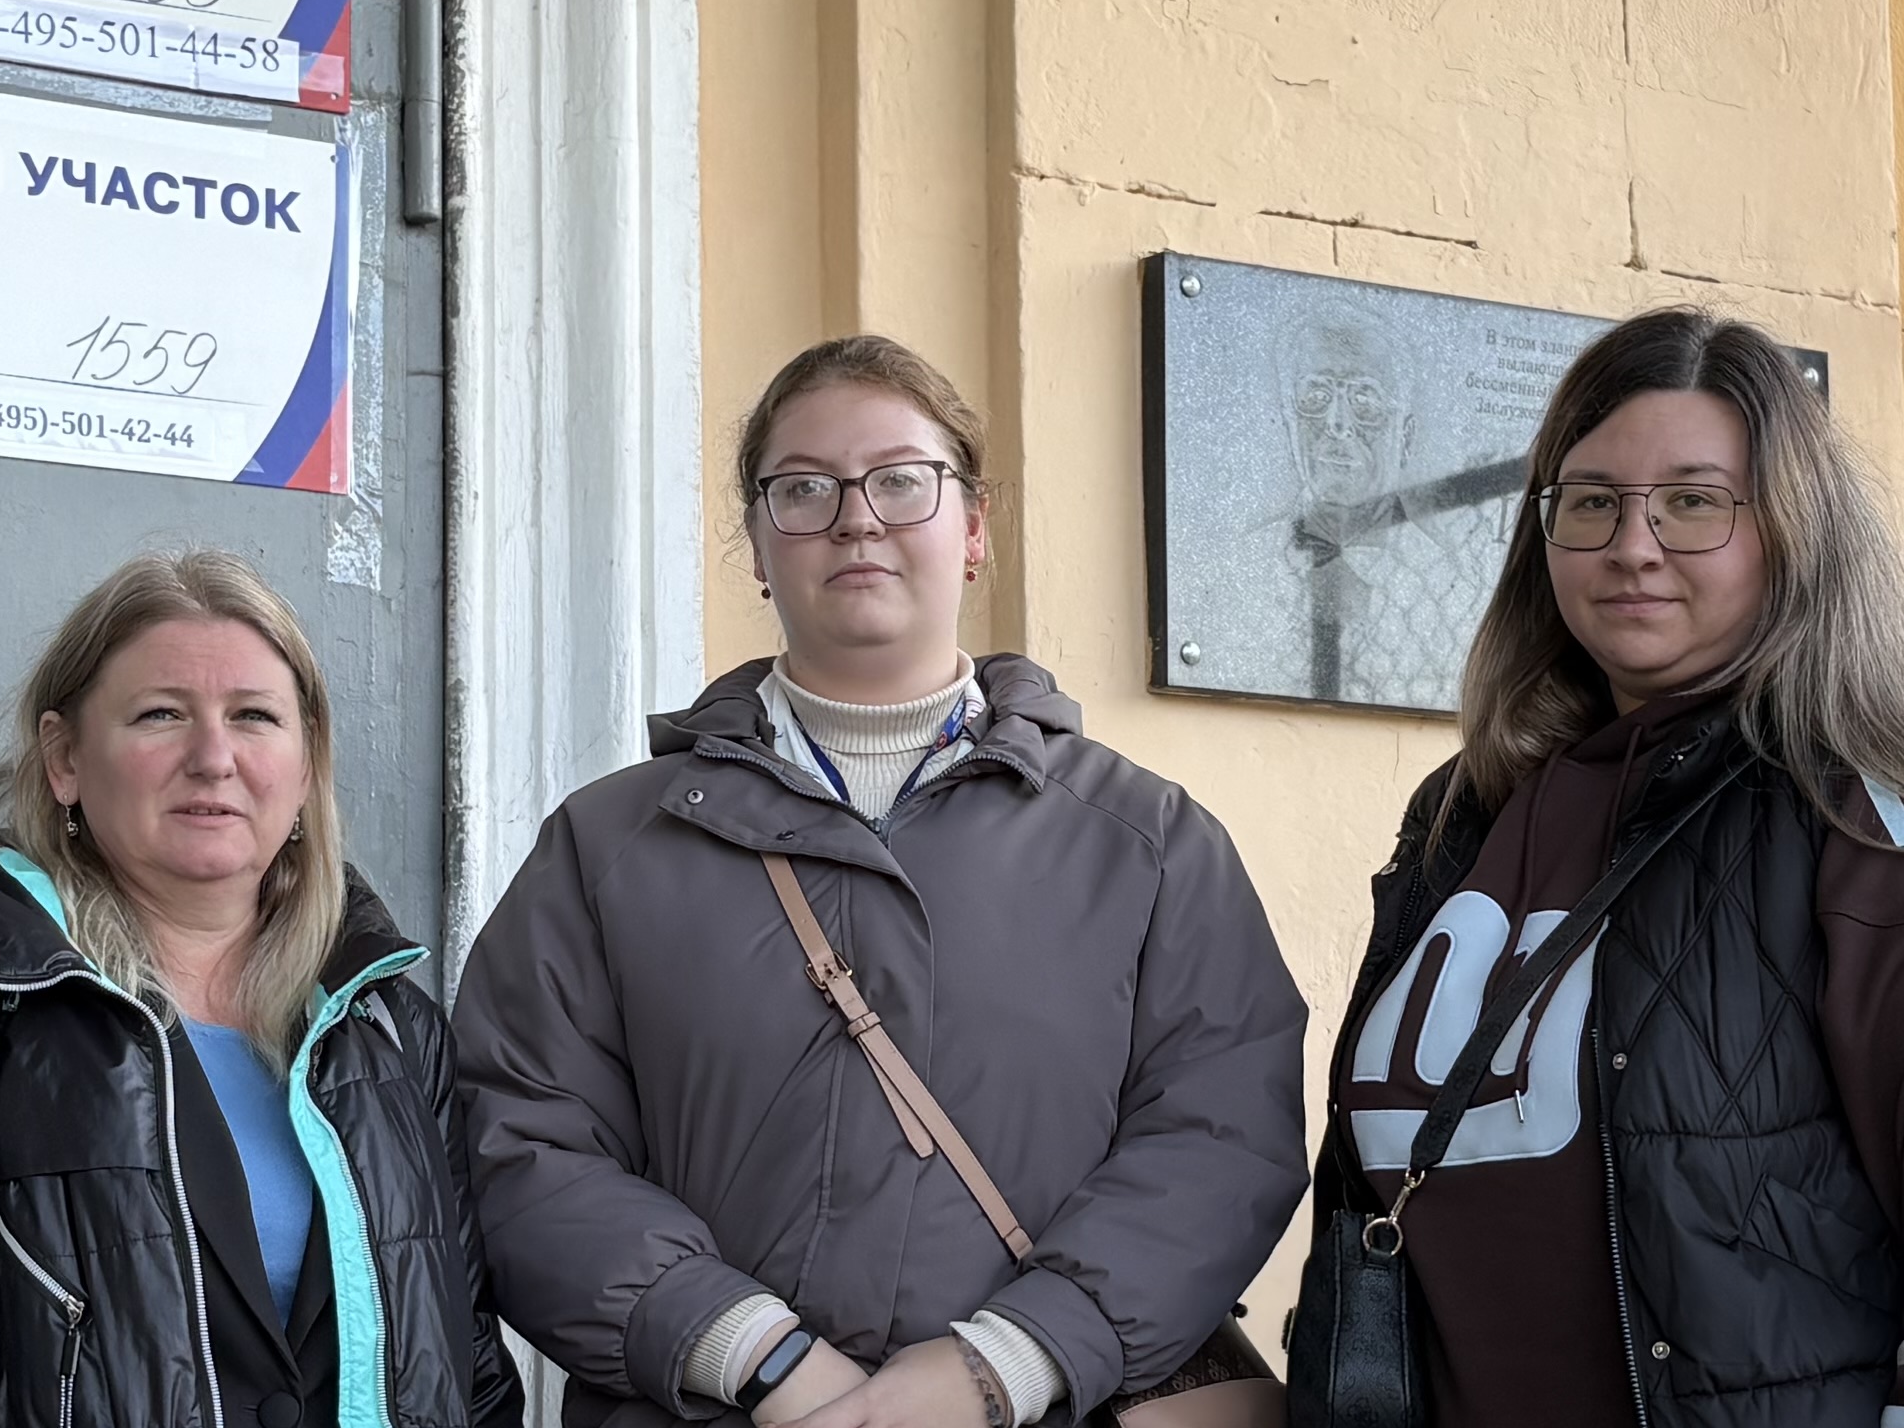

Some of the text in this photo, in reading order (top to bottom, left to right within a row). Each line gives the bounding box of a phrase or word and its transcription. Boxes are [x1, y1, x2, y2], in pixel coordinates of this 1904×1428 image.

[19, 152, 302, 233] УЧАСТОК
[66, 315, 217, 395] 1559
[1485, 328, 1497, 345] В
